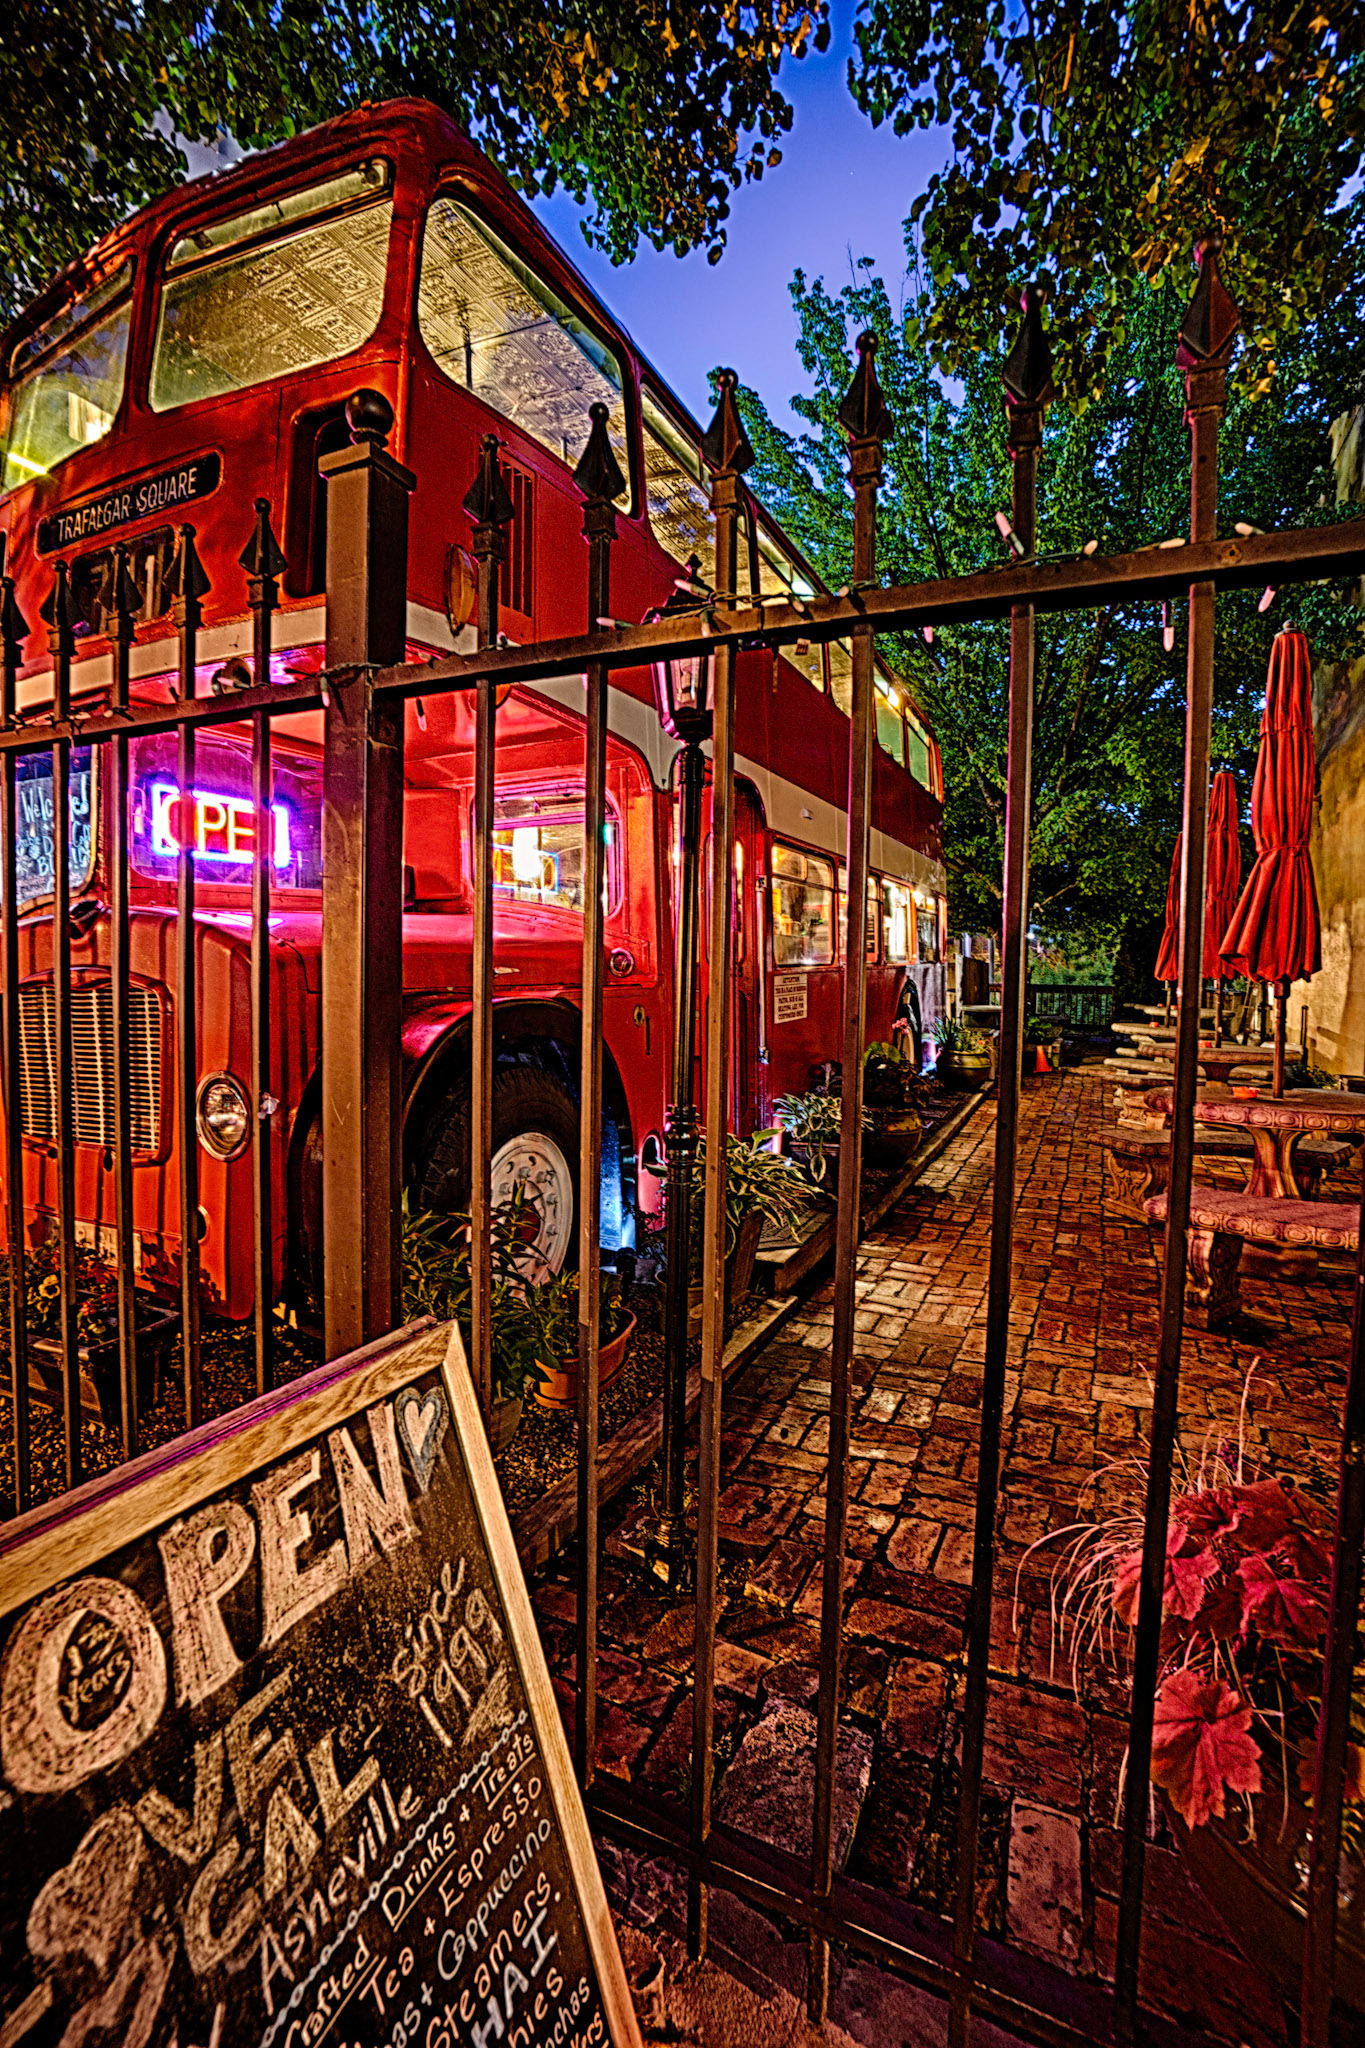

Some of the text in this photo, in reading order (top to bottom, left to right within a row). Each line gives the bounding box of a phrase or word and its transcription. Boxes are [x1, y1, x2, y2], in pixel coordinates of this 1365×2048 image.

[57, 467, 198, 542] TRAFALGAR SQUARE
[159, 793, 283, 862] OPE
[2, 1402, 420, 1794] OPEN
[419, 1587, 504, 1749] 1999
[260, 1778, 423, 2016] Asheville
[358, 1945, 415, 2016] Tea
[437, 1776, 542, 1918] Espresso
[381, 1821, 457, 1928] Drinks
[472, 1732, 534, 1803] Treats
[437, 1818, 551, 1980] Cappuccino
